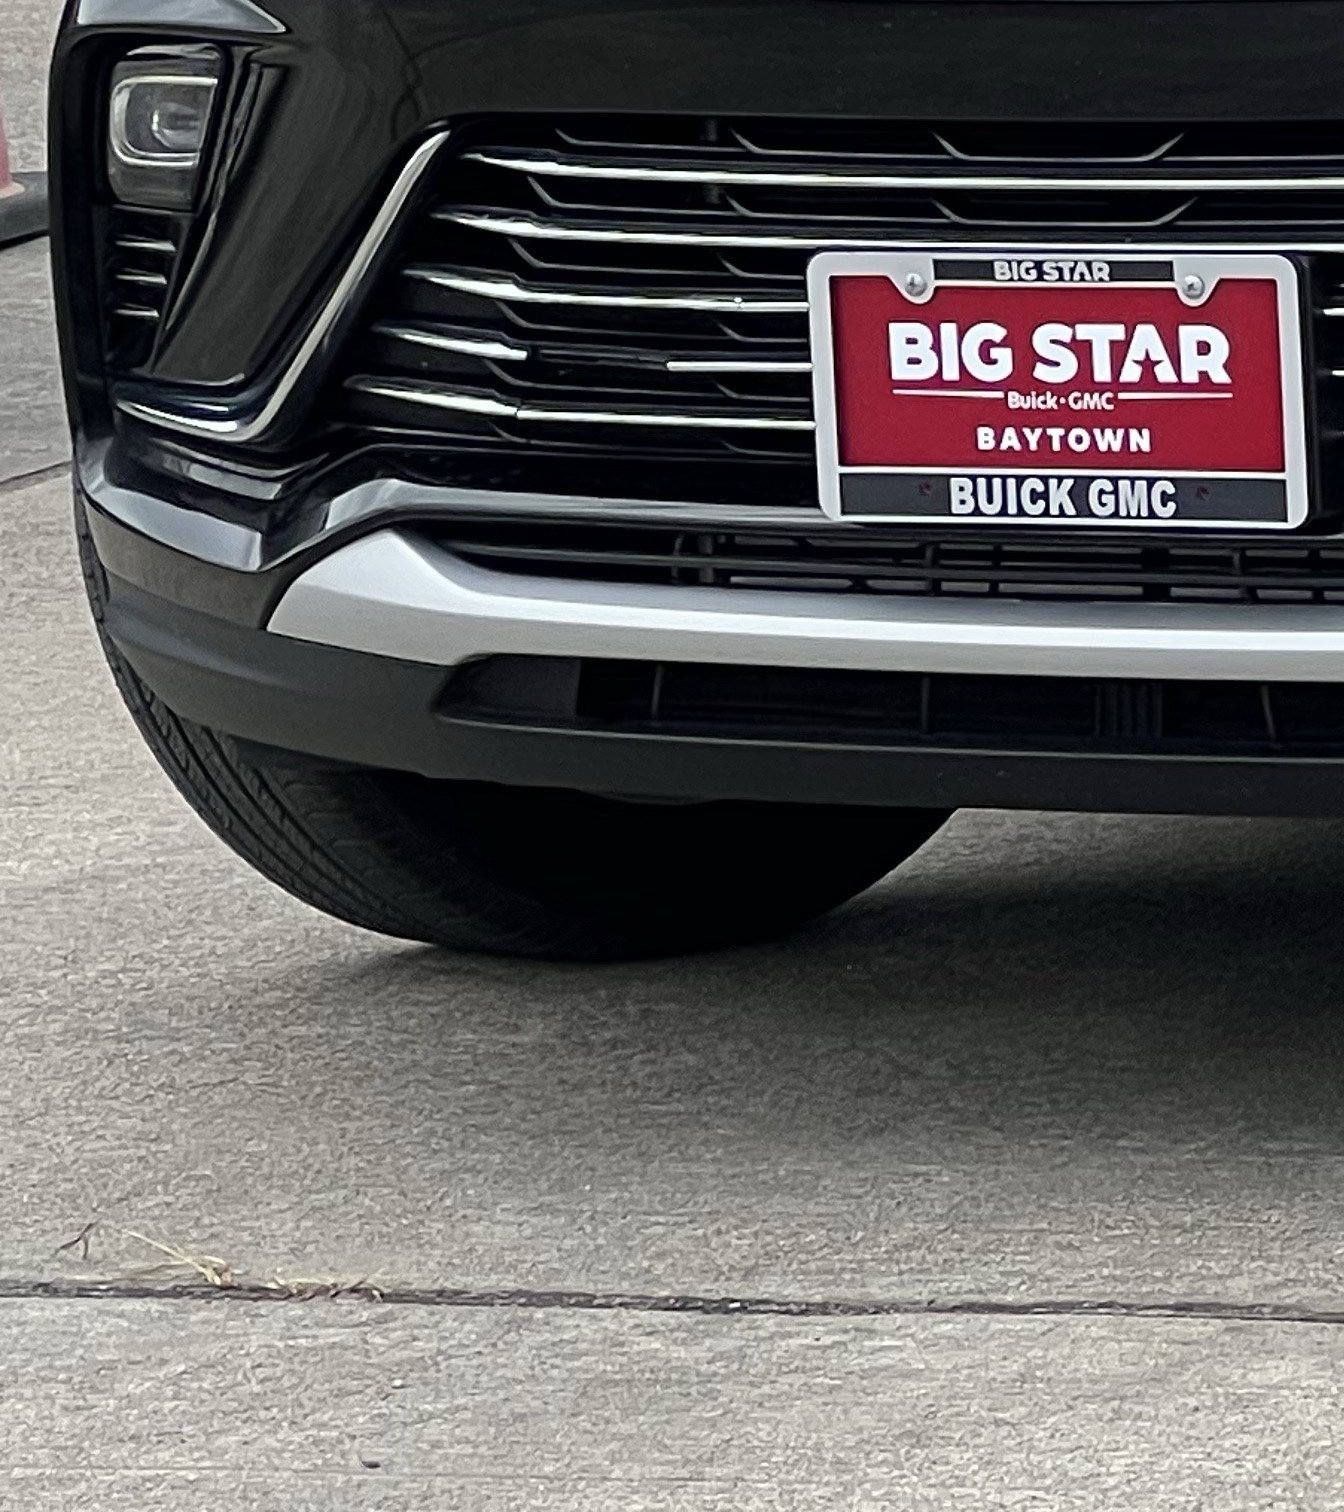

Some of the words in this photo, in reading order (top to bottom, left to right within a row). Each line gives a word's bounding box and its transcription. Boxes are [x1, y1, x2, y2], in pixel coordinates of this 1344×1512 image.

[994, 261, 1037, 281] BIG
[1042, 261, 1110, 281] STAR
[888, 322, 1013, 382] BIG
[1032, 323, 1231, 384] STAR
[1008, 391, 1058, 410] Buick
[1068, 392, 1114, 410] GMC
[976, 427, 1151, 453] BAYTOWN
[950, 477, 1077, 516] BUICK
[1089, 479, 1177, 518] GMC
